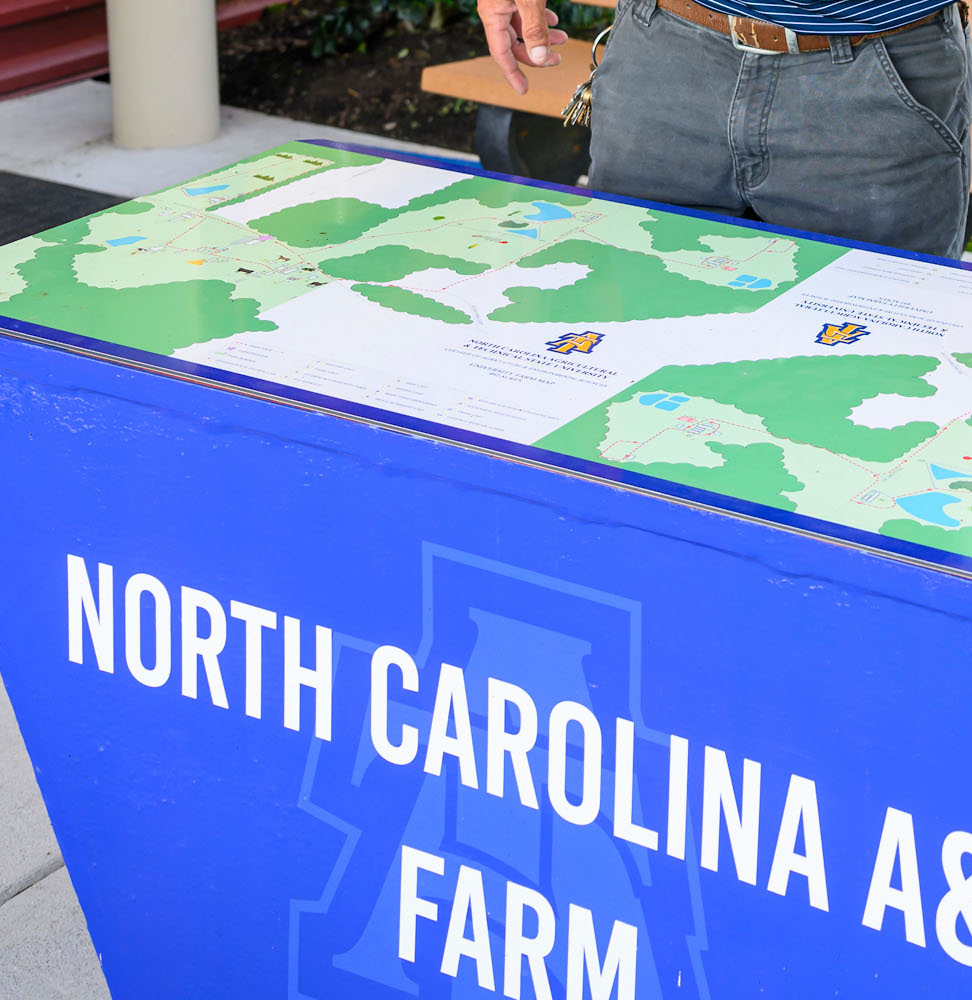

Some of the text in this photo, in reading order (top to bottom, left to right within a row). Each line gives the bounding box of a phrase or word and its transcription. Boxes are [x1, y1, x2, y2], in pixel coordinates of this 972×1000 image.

[67, 554, 332, 742] NORTH
[370, 645, 829, 913] CAROLINA
[398, 845, 638, 1000] FARM
